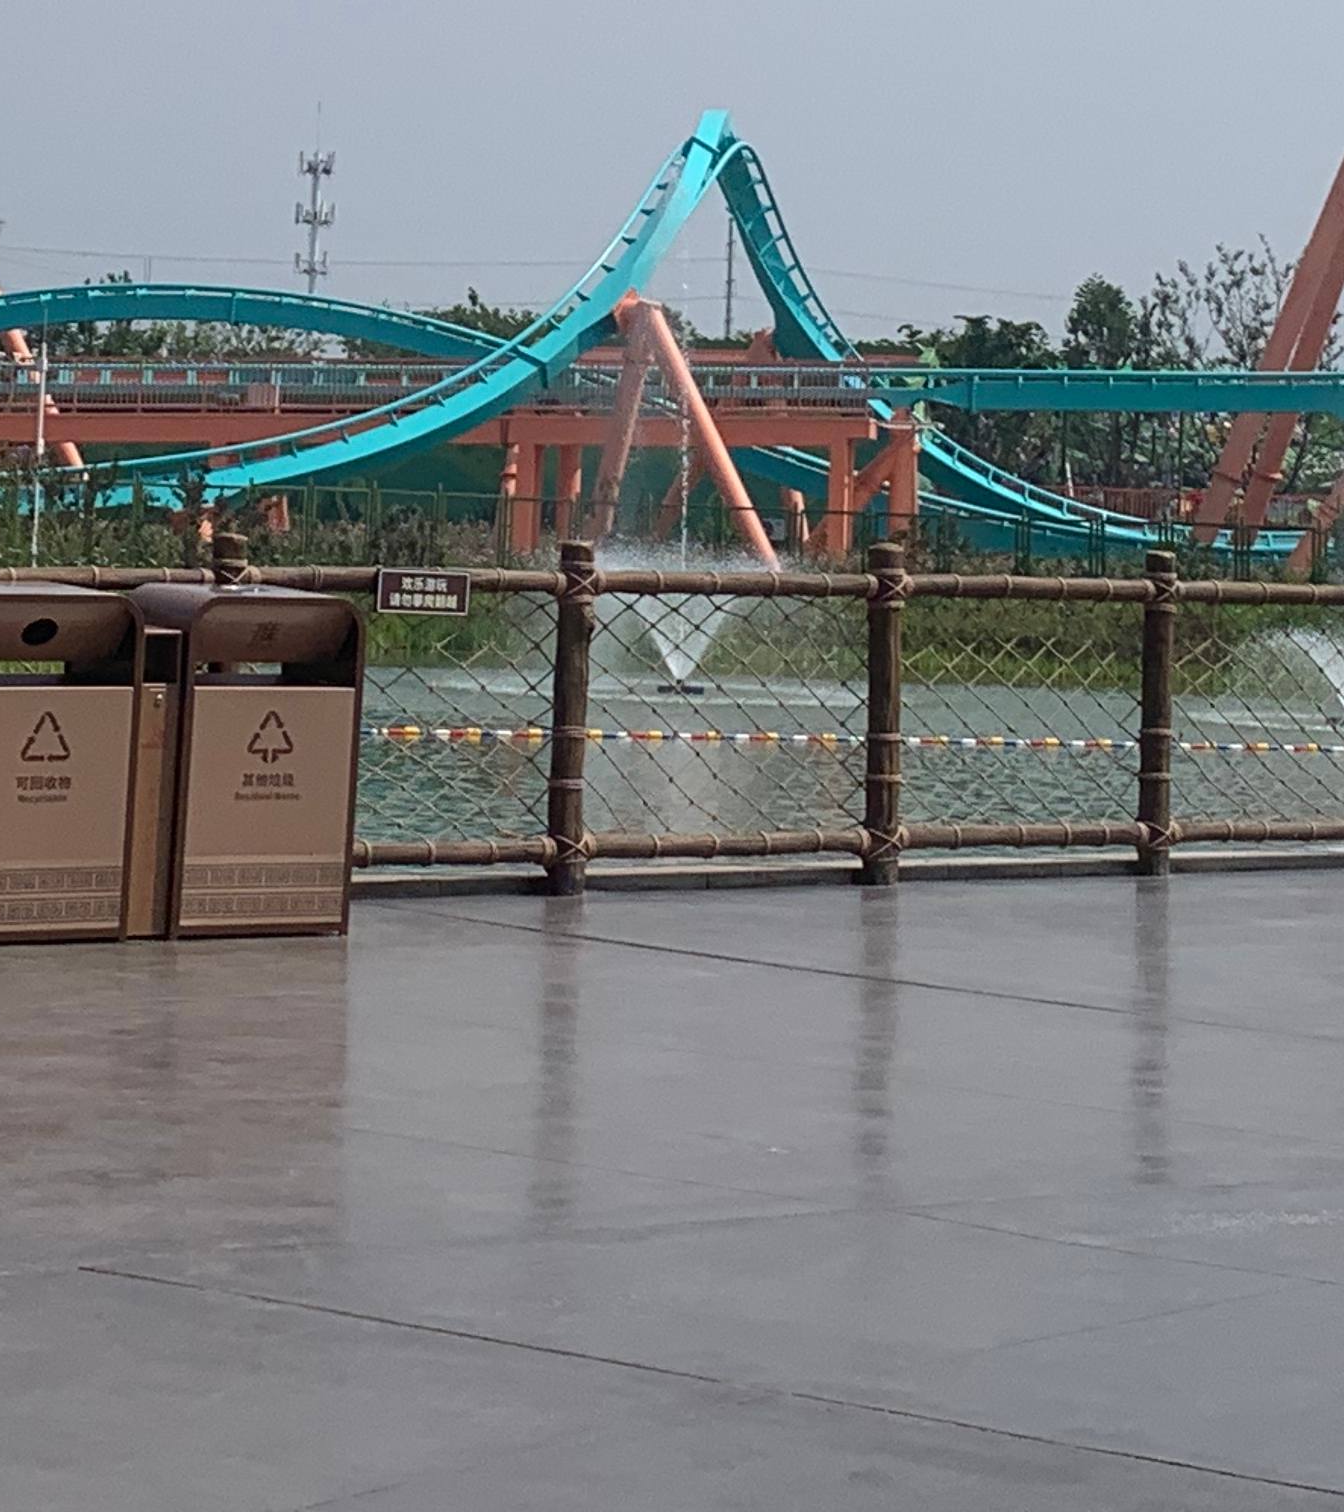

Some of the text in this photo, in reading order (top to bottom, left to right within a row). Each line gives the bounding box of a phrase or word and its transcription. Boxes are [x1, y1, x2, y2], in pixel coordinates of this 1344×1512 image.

[401, 576, 447, 592] 欢乐游玩
[16, 776, 71, 790] 可回收物
[242, 773, 294, 787] 其他垃圾
